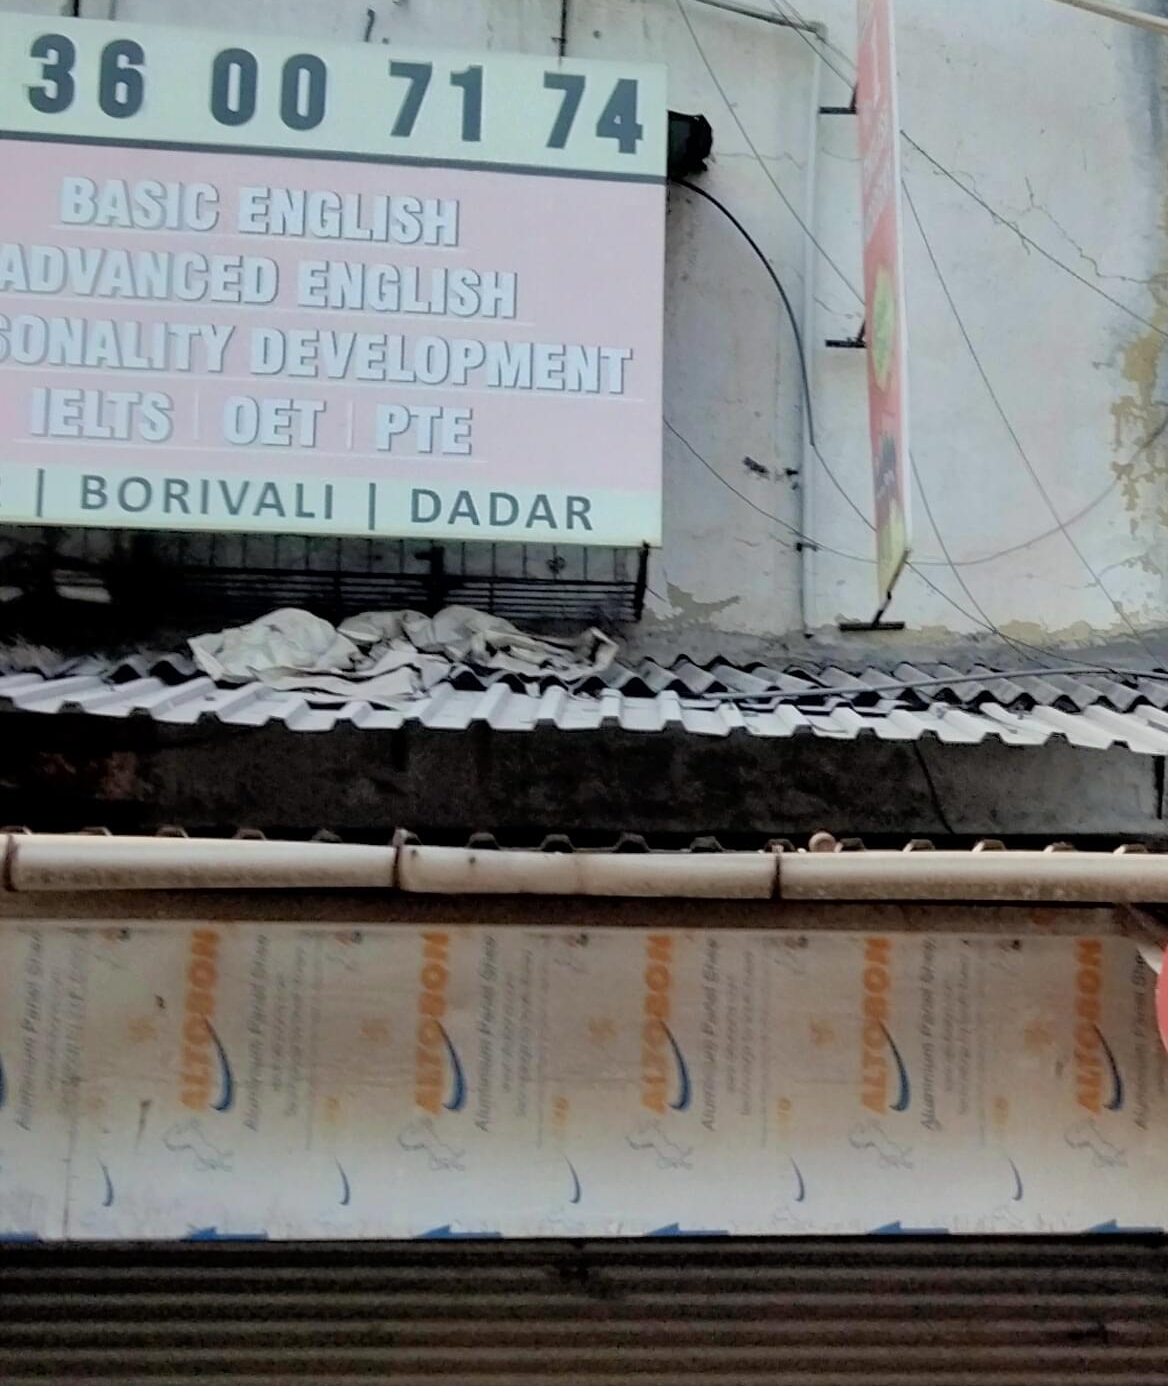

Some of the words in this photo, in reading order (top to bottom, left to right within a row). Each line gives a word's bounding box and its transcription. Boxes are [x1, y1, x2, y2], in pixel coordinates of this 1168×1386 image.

[27, 33, 146, 119] 36
[210, 47, 328, 131] 00
[388, 59, 484, 143] 71
[542, 71, 643, 155] 74
[58, 176, 220, 232] BASIC
[236, 186, 459, 247] ENGLISH
[0, 243, 279, 304] ADVANCED
[297, 260, 518, 319] ENGLISH
[249, 327, 633, 395] DEVELOPMENT
[28, 387, 174, 442] IELTS
[221, 395, 326, 448] OET
[374, 403, 473, 456] PTE
[79, 474, 334, 522] BORIVALI
[409, 488, 594, 531] DADAR
